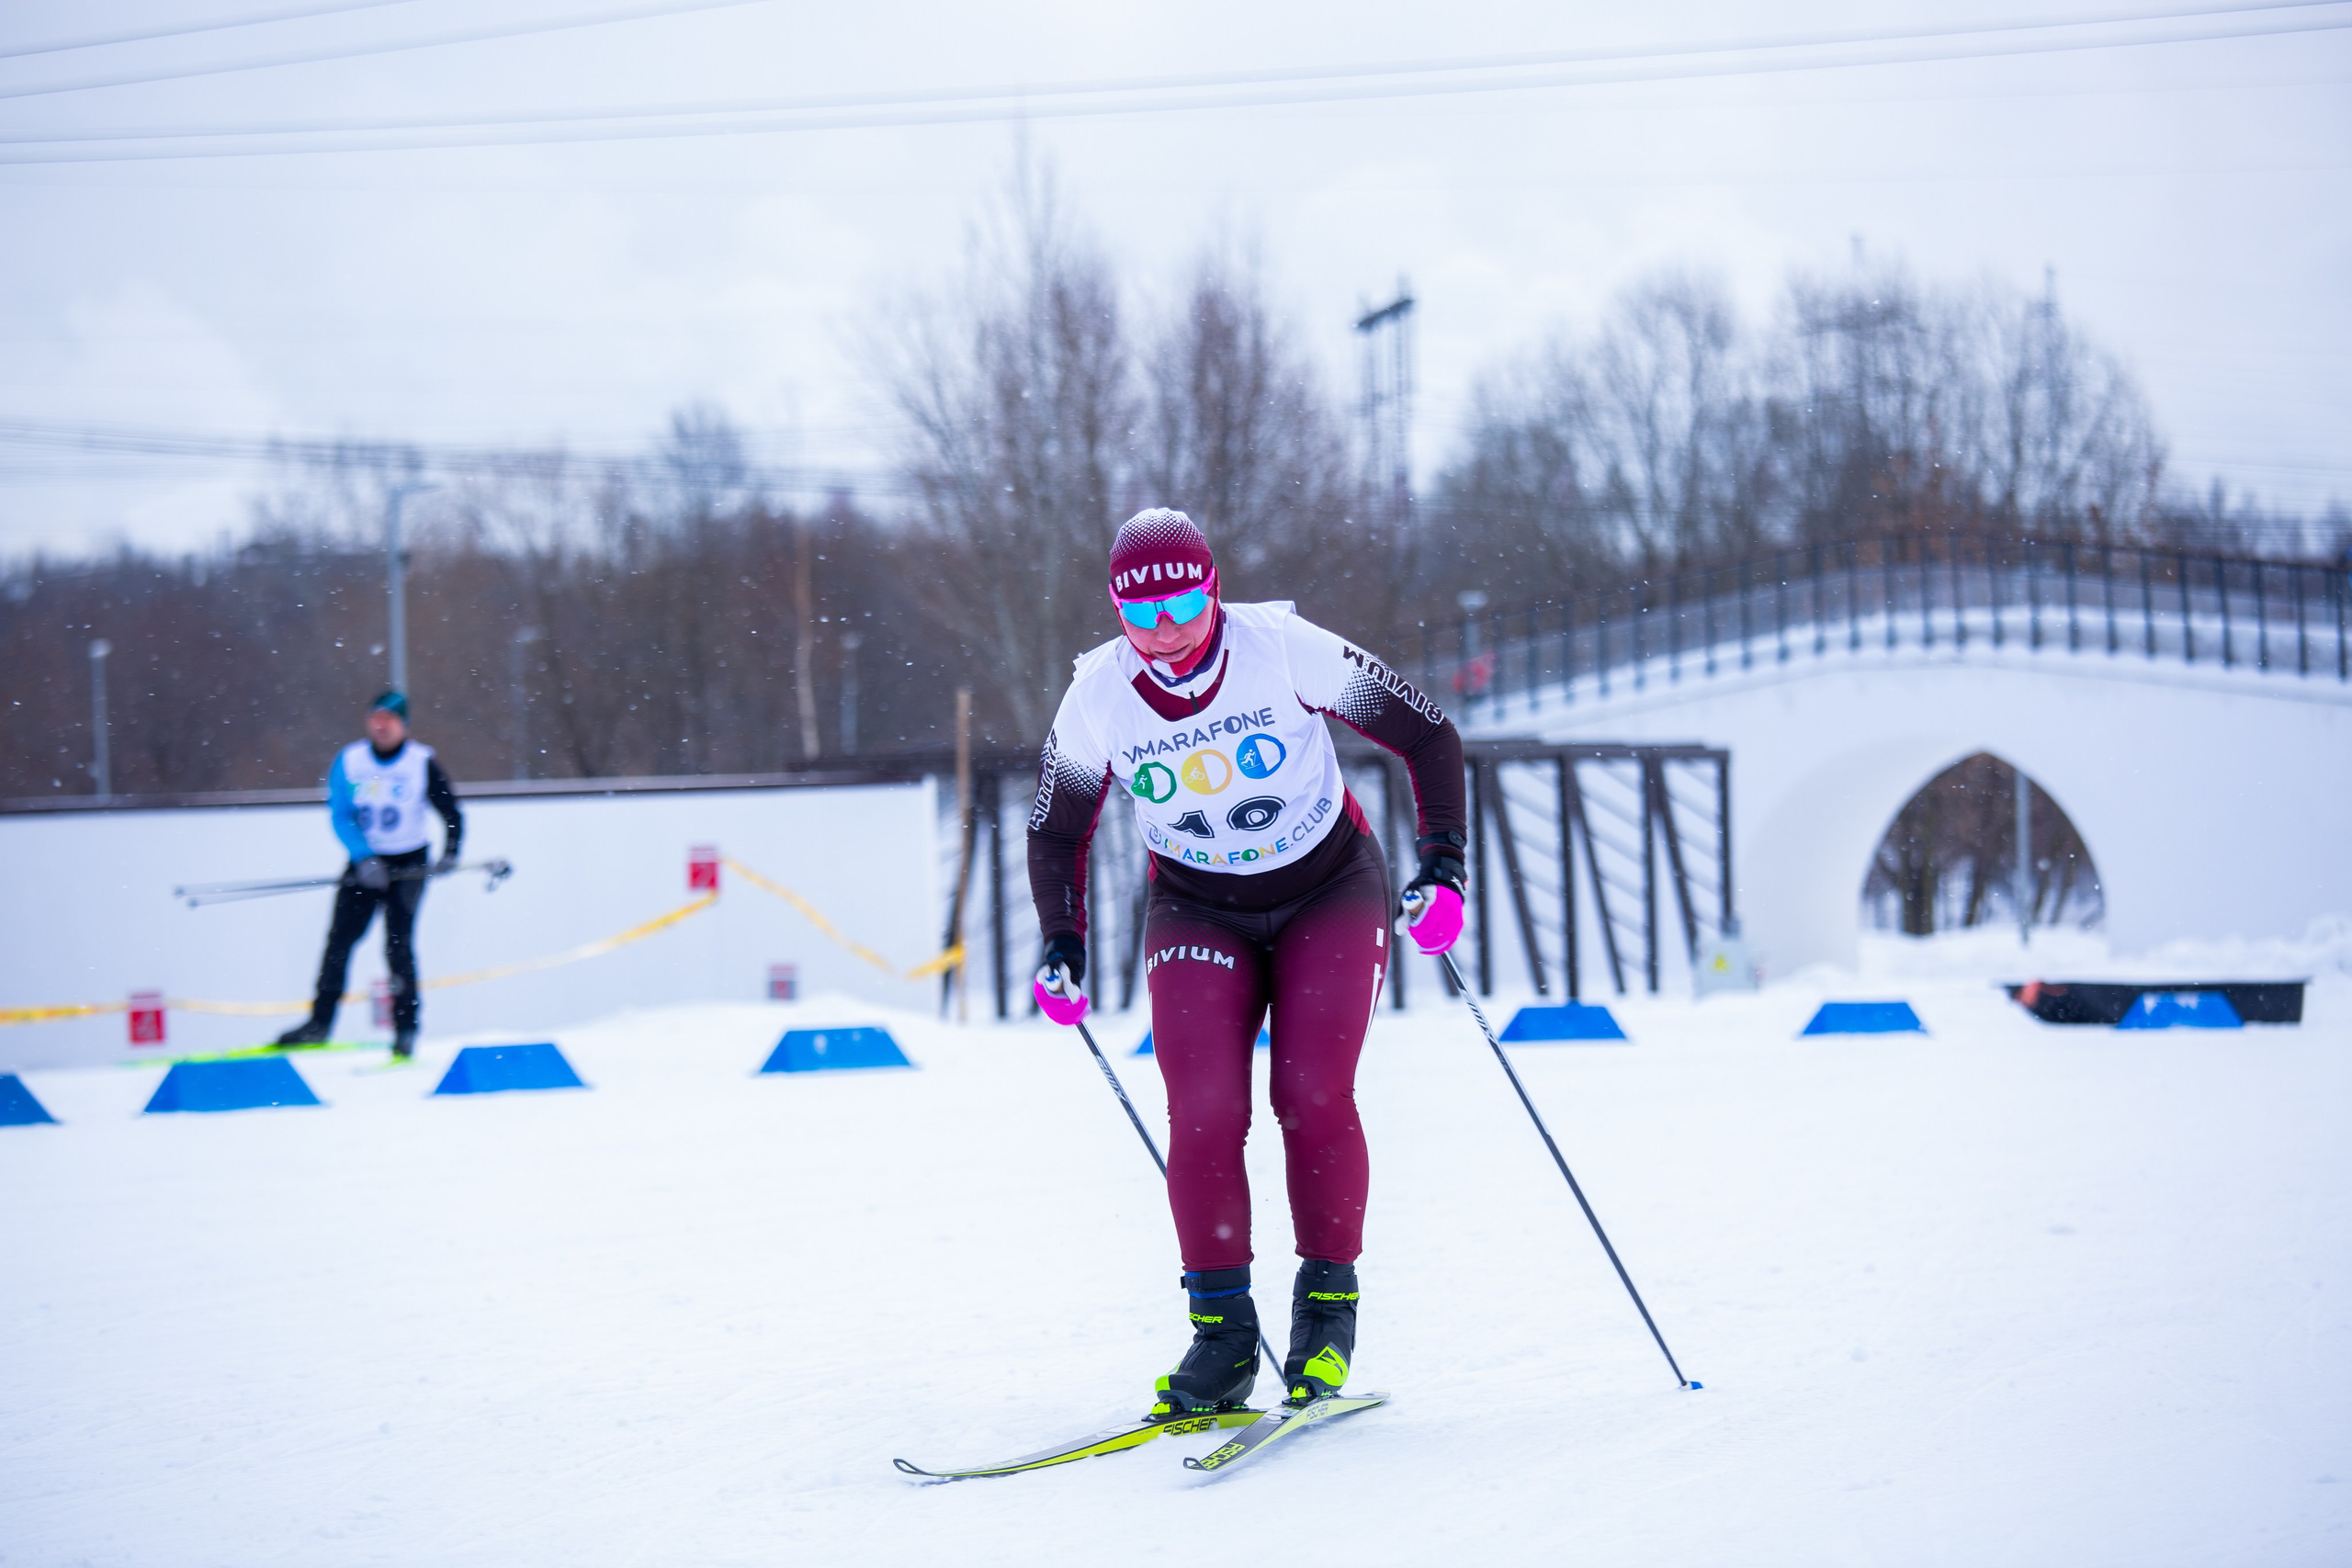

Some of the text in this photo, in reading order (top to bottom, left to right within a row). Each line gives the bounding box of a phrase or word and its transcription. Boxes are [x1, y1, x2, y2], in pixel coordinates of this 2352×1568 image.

[1114, 562, 1203, 592] BIVIUM
[1342, 645, 1444, 725] BIVIUM
[1122, 706, 1275, 764] VMARAFONE
[1147, 945, 1235, 976] BIVIUM
